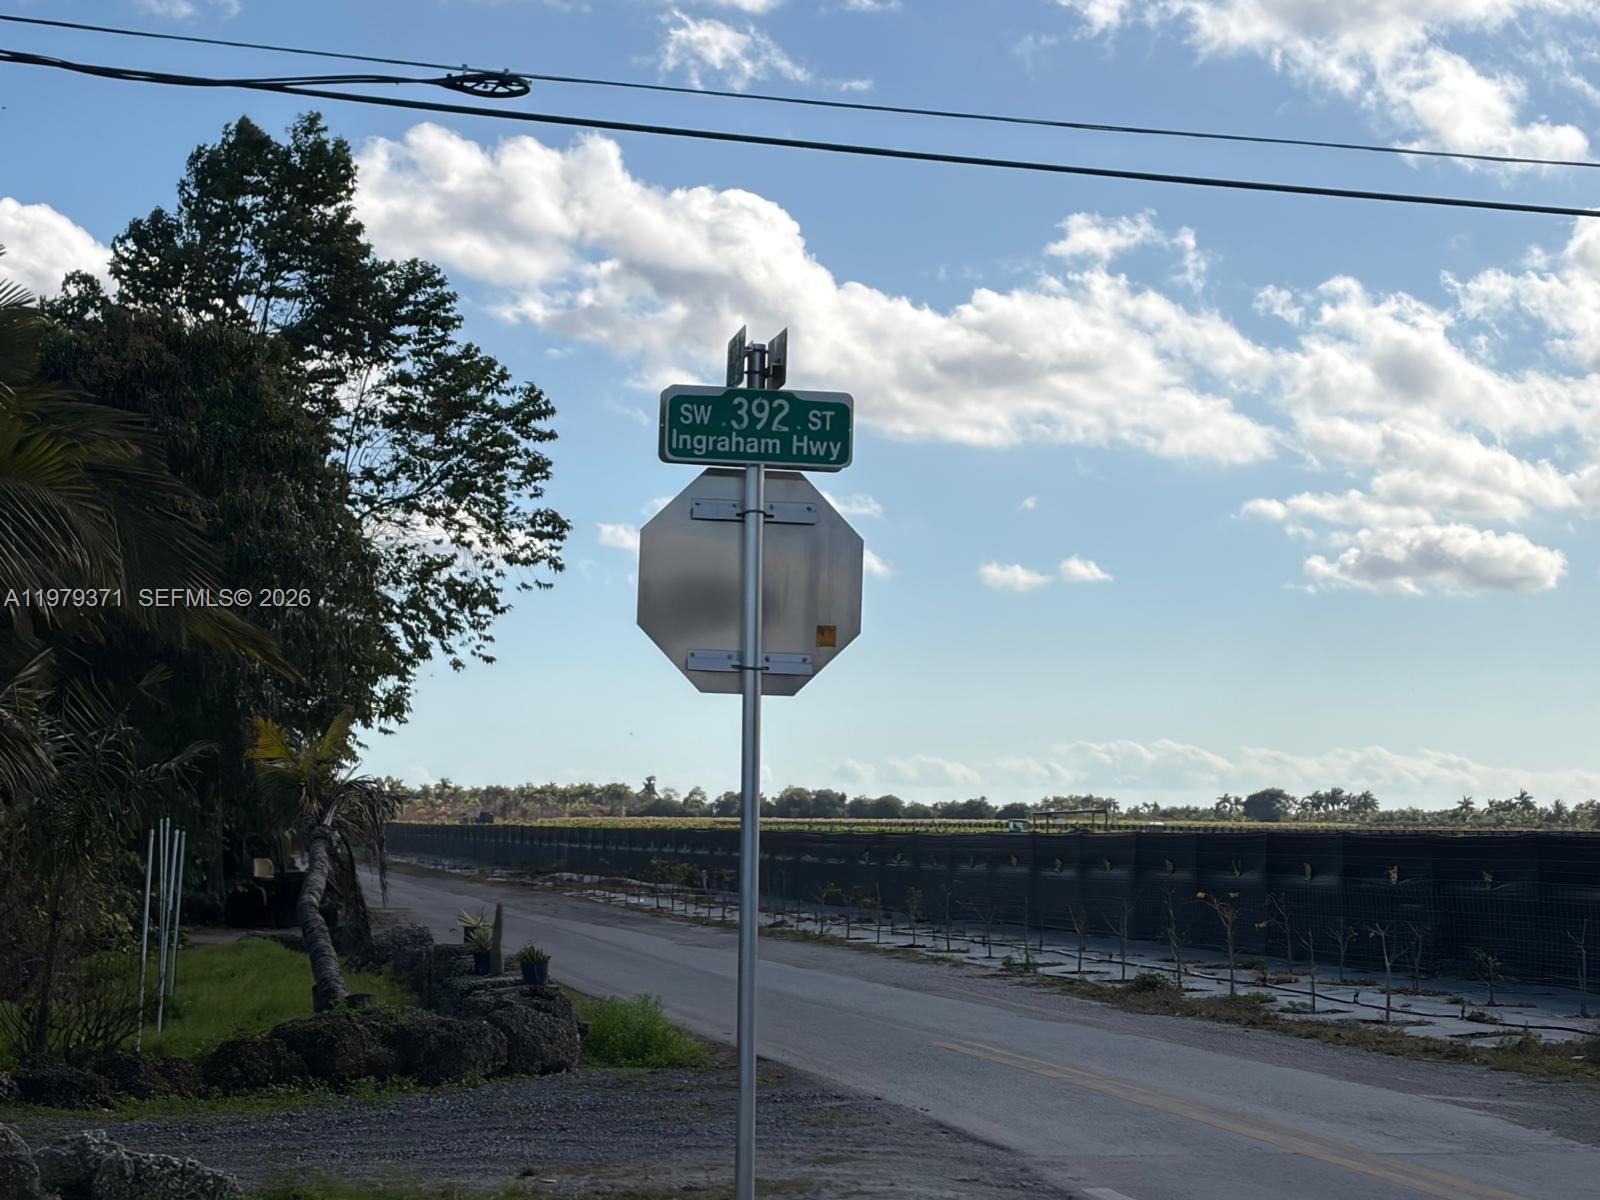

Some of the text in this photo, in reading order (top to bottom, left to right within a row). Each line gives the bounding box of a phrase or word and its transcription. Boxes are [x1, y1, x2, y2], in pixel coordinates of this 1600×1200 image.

[680, 397, 835, 432] SW 392 ST
[671, 428, 842, 461] Ingraham Hwy
